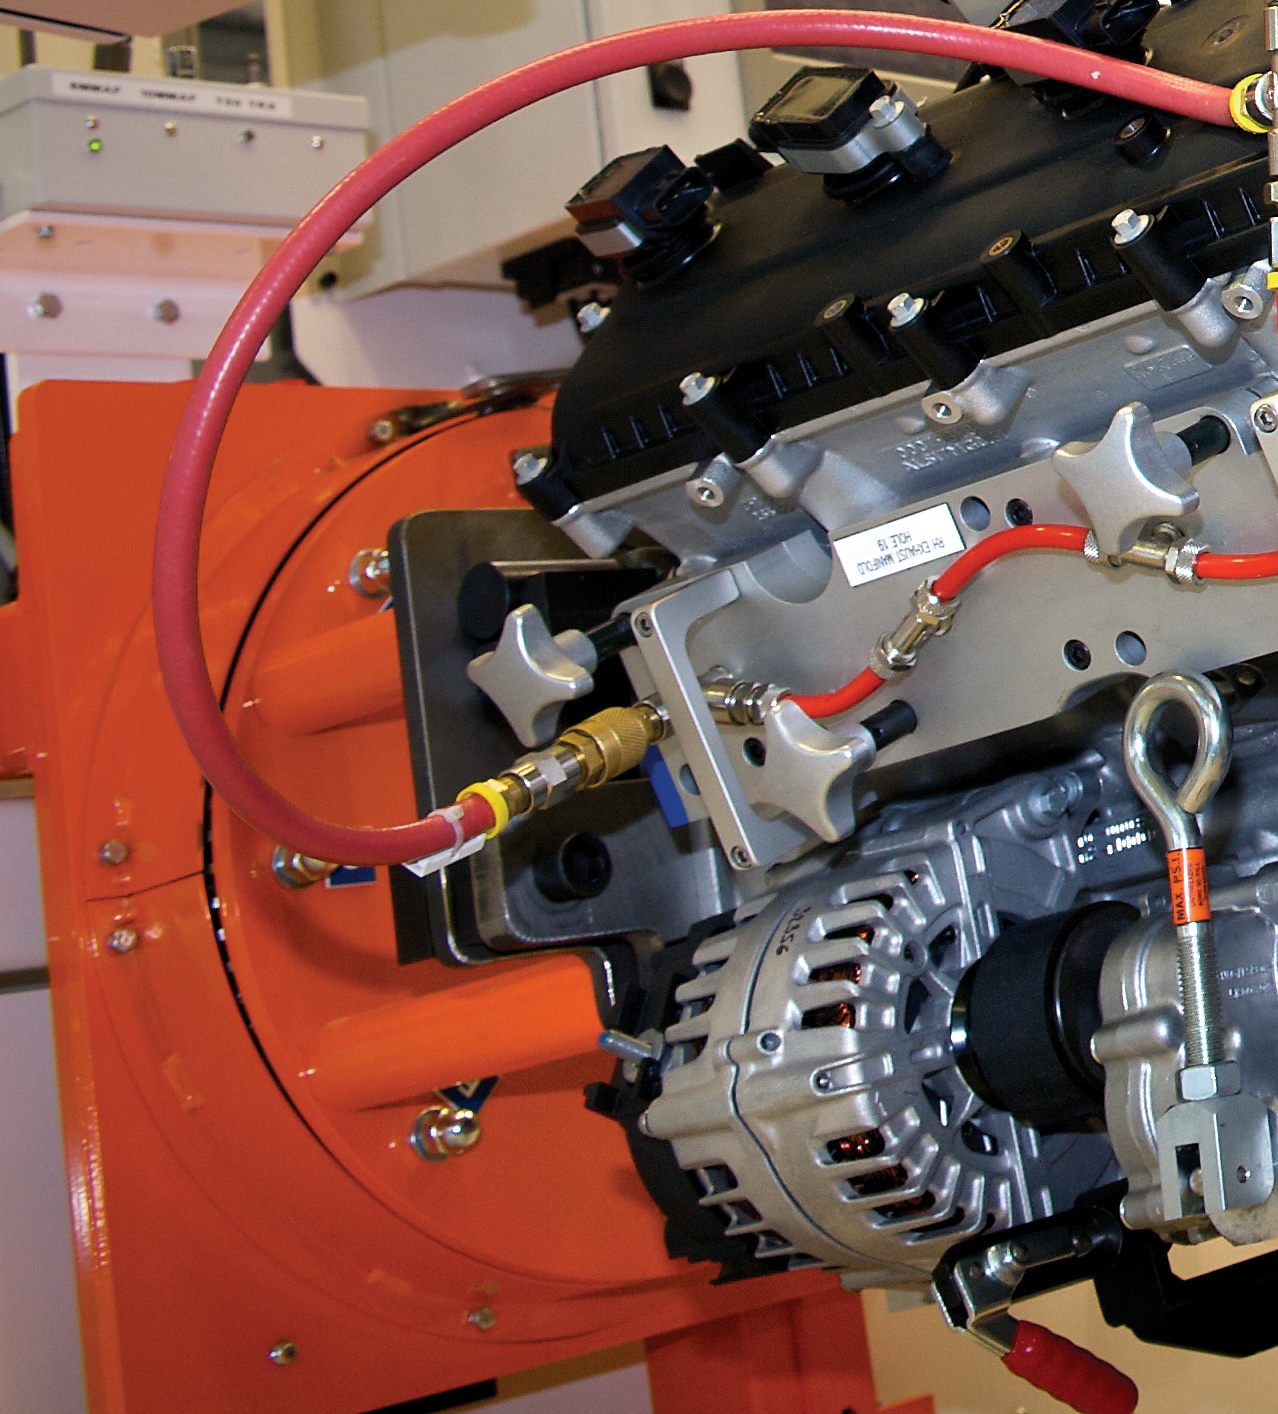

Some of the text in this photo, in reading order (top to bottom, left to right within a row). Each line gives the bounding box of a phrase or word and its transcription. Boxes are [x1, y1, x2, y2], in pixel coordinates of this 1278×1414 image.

[889, 530, 912, 549] HOLE
[856, 536, 945, 576] RH EXHAUST MANIFOLD
